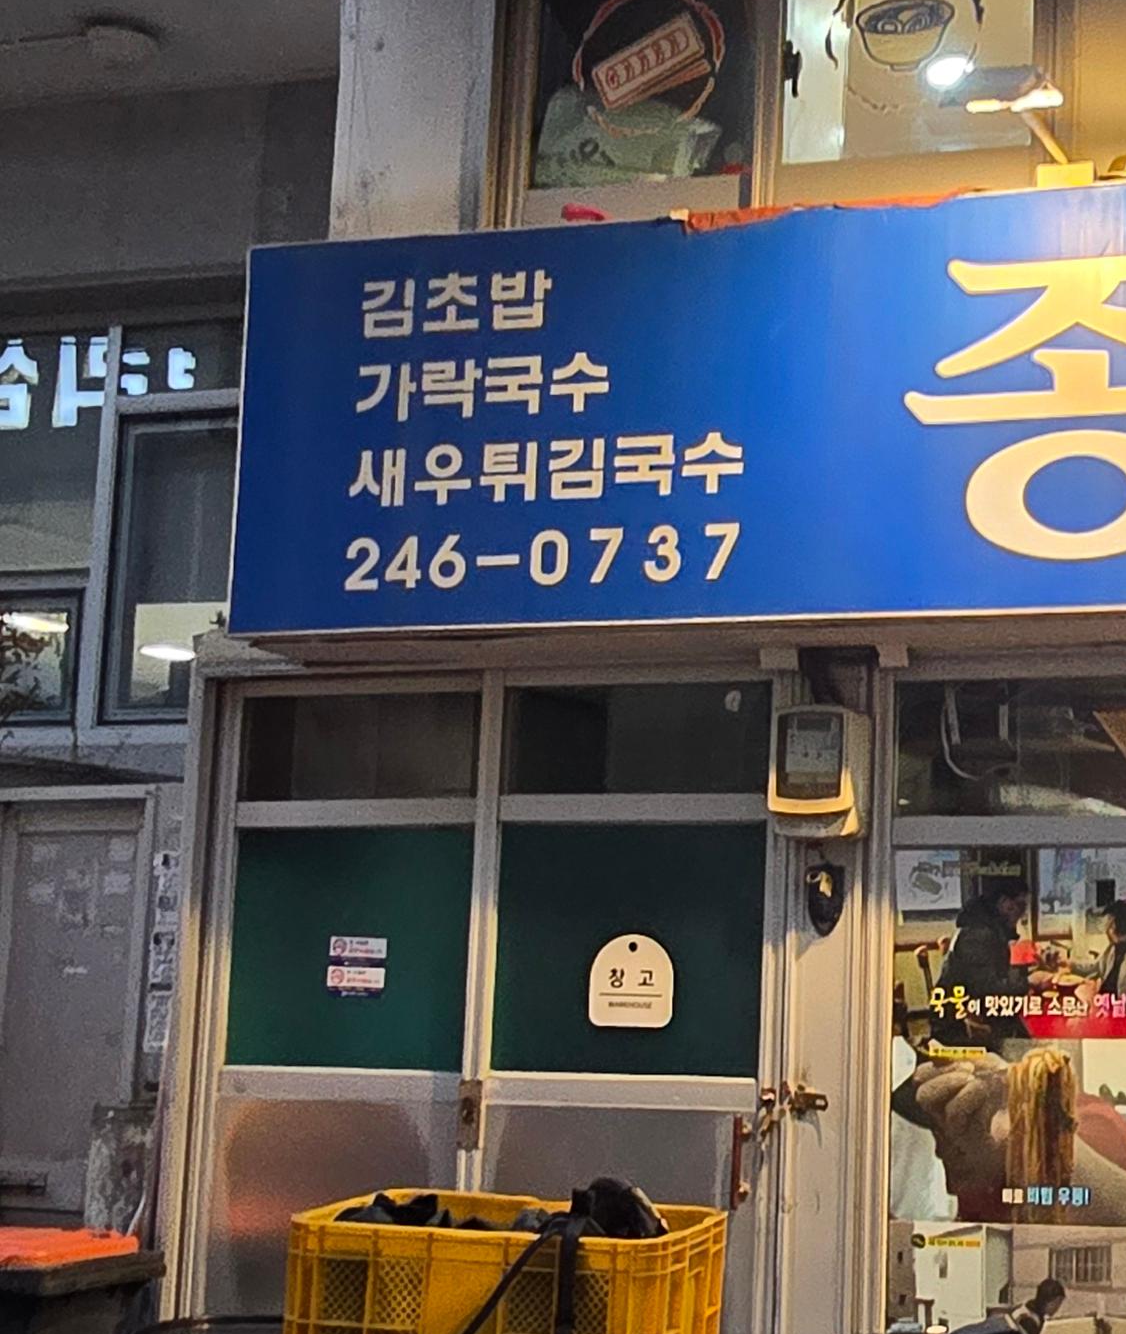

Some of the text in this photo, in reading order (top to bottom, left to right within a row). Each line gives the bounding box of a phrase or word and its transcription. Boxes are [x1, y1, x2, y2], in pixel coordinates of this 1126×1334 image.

[361, 269, 552, 339] 김초밥
[356, 352, 609, 422] 가락국수
[349, 431, 745, 507] 새우튀김국수
[344, 522, 741, 591] 246-0737
[608, 967, 655, 988] 창고
[985, 995, 1043, 1017] 맛있기로
[1047, 994, 1089, 1017] 소문난
[1094, 993, 1126, 1018] 옛날
